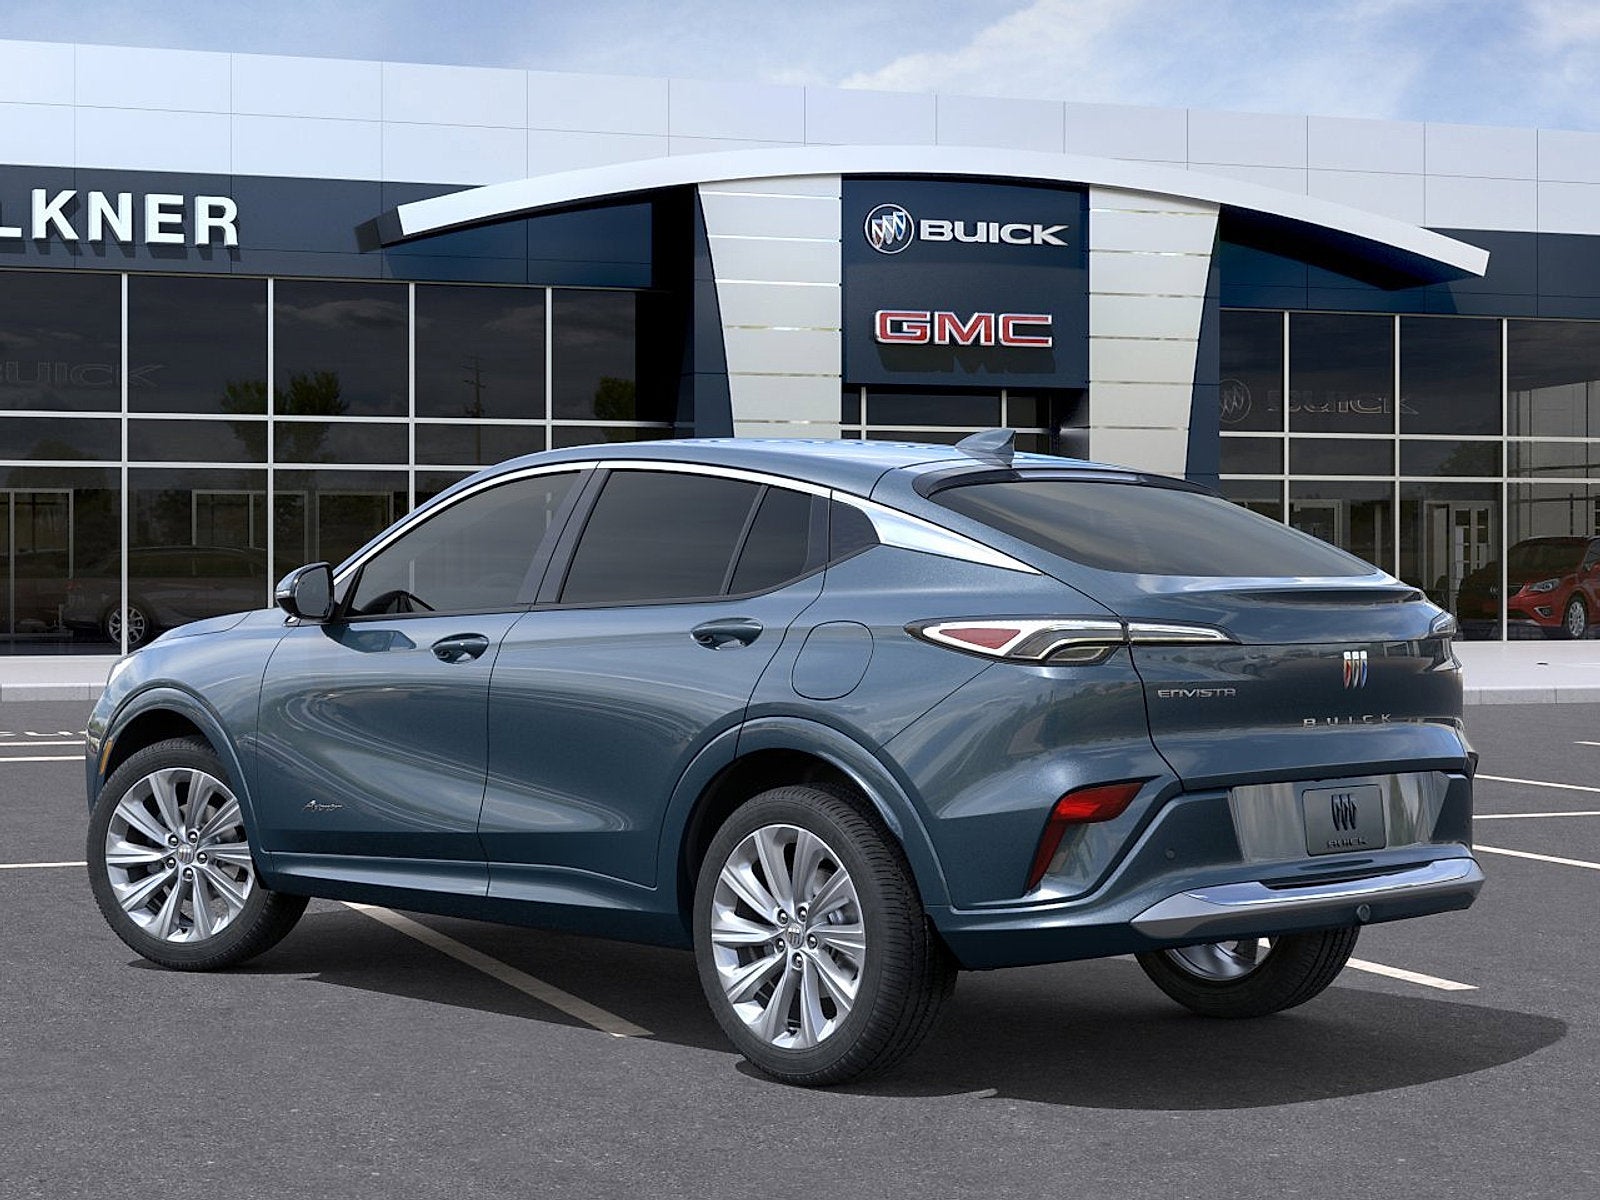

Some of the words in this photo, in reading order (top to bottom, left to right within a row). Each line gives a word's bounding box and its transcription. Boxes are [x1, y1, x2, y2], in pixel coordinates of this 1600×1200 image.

[919, 219, 1069, 247] BUICK
[875, 309, 1053, 348] GMC
[0, 360, 165, 389] UICK
[1157, 688, 1237, 699] ENVISTA
[1303, 713, 1392, 728] BUICK
